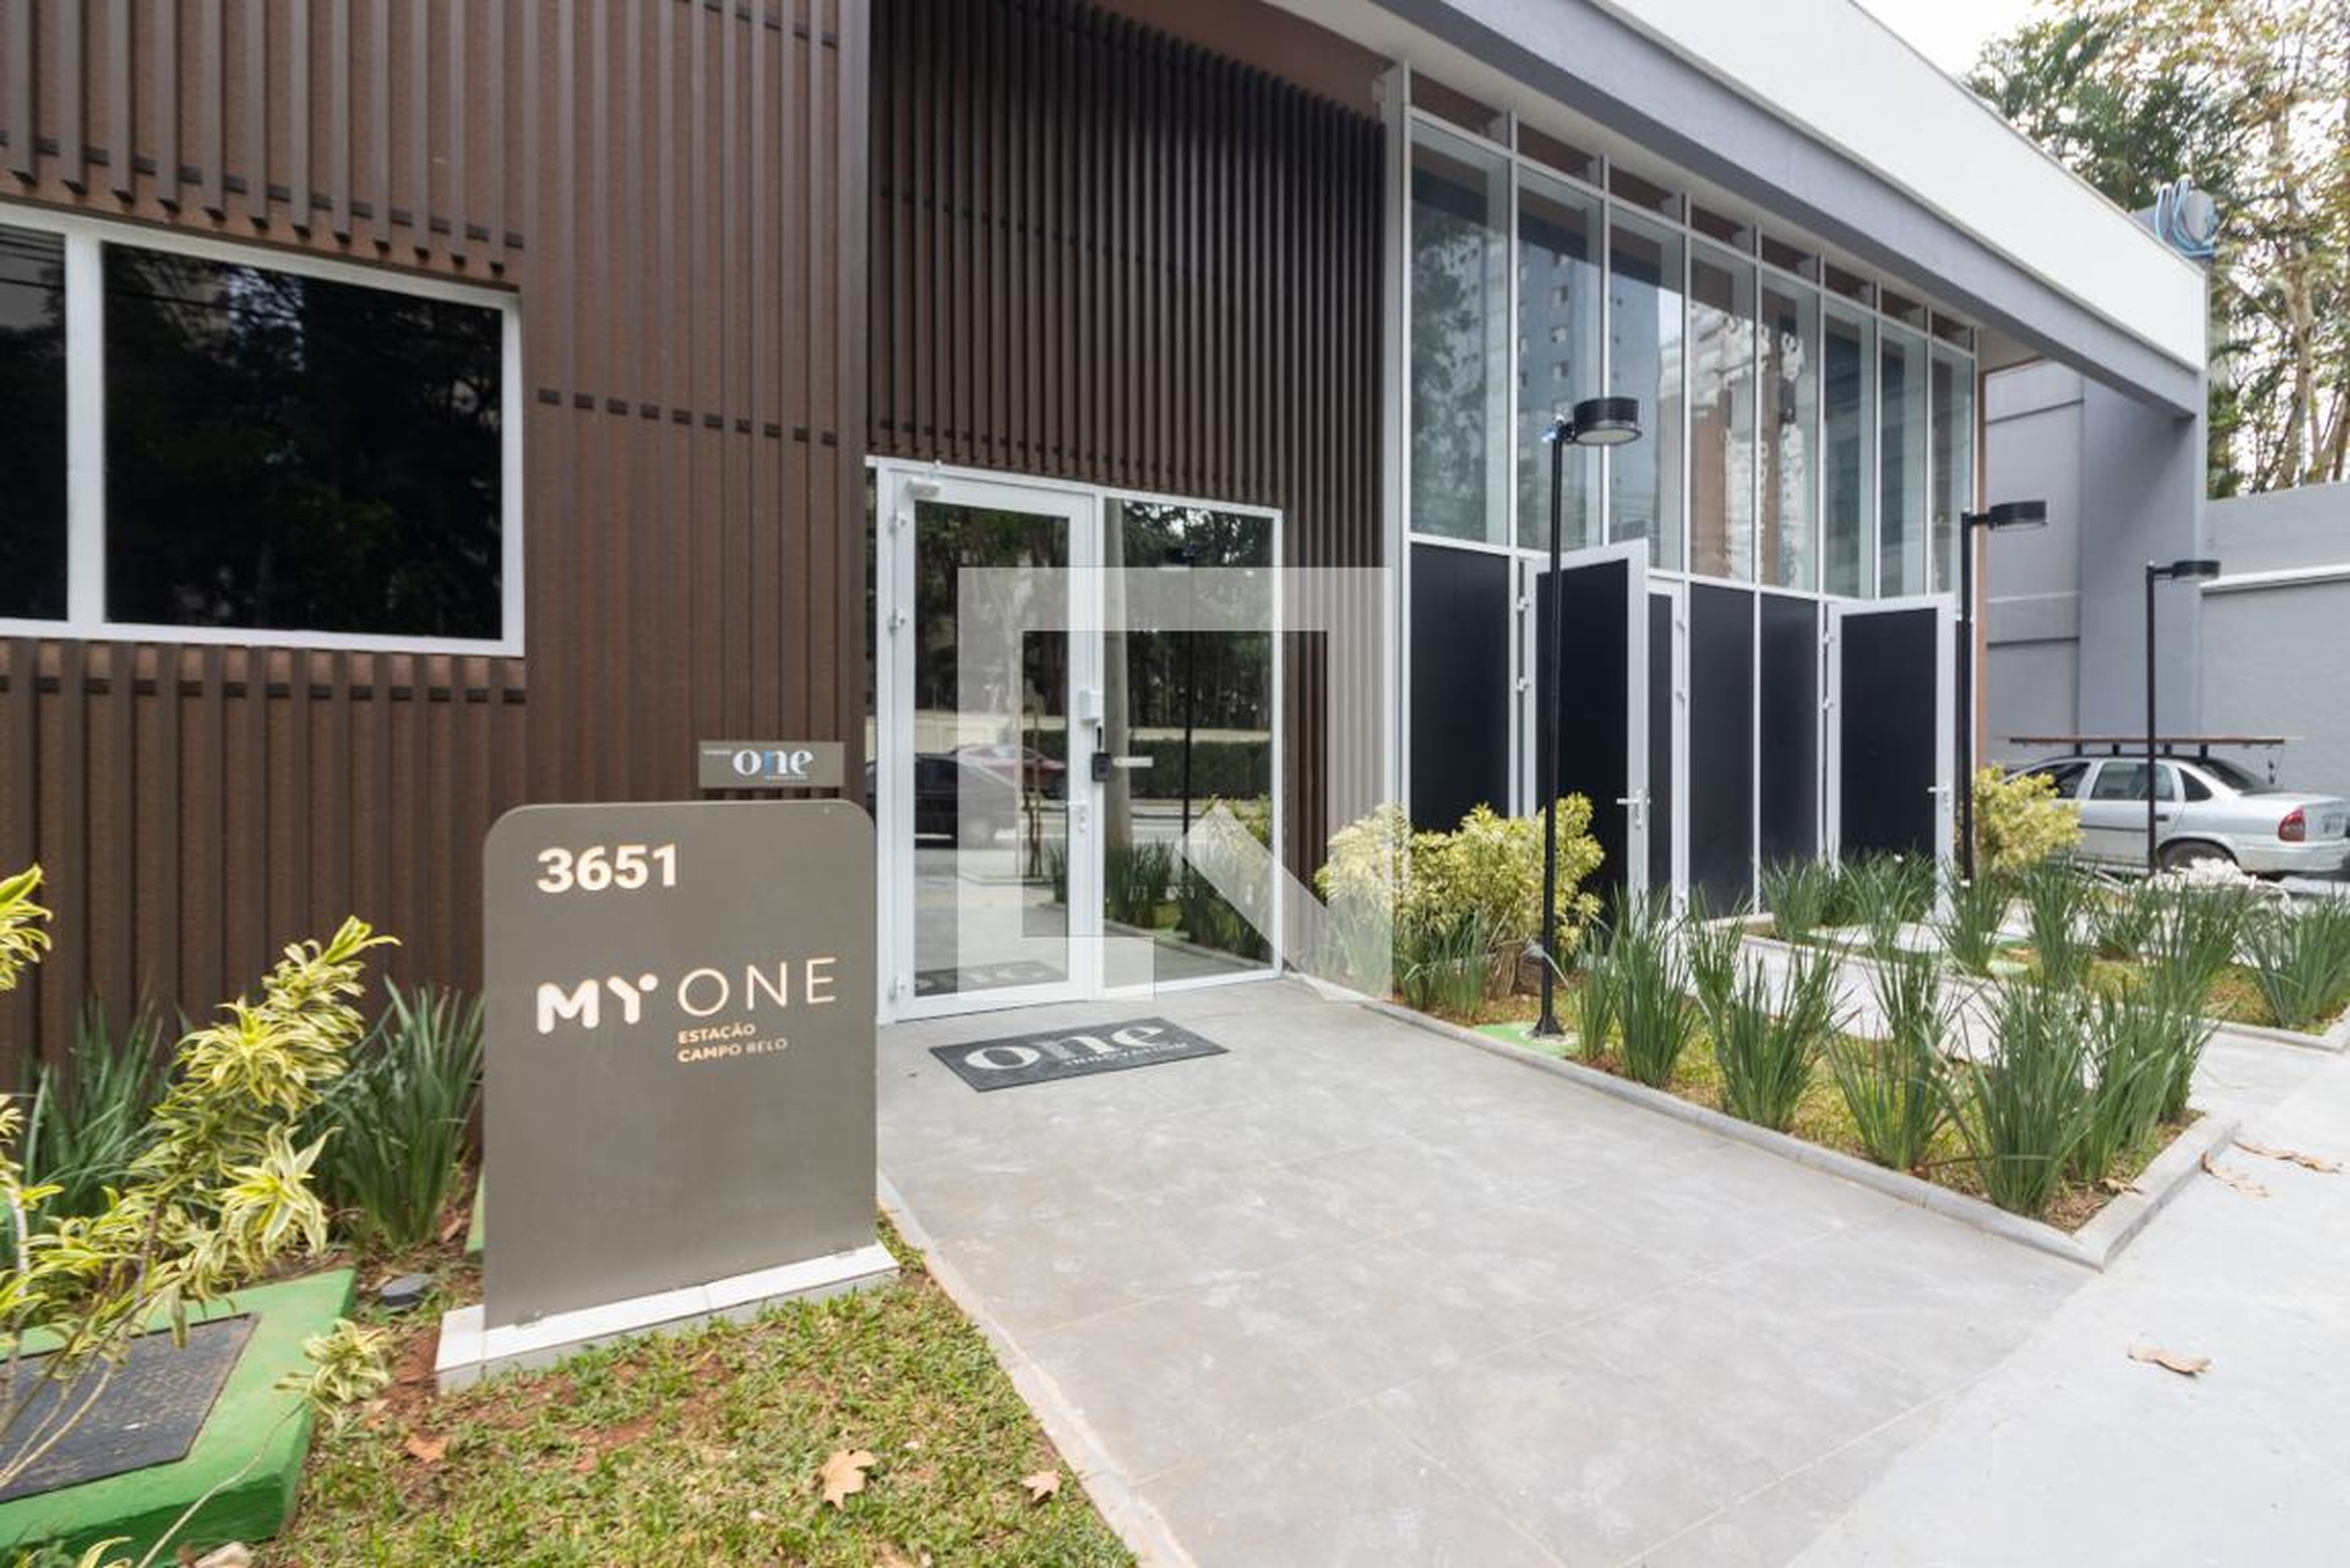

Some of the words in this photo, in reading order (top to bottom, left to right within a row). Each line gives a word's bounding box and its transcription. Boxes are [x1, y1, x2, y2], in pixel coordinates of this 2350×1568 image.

[733, 749, 814, 775] one
[537, 843, 676, 893] 3651
[537, 973, 658, 1034] MY
[677, 957, 836, 1017] ONE
[677, 1044, 742, 1062] CAMPO
[964, 1026, 1163, 1069] one
